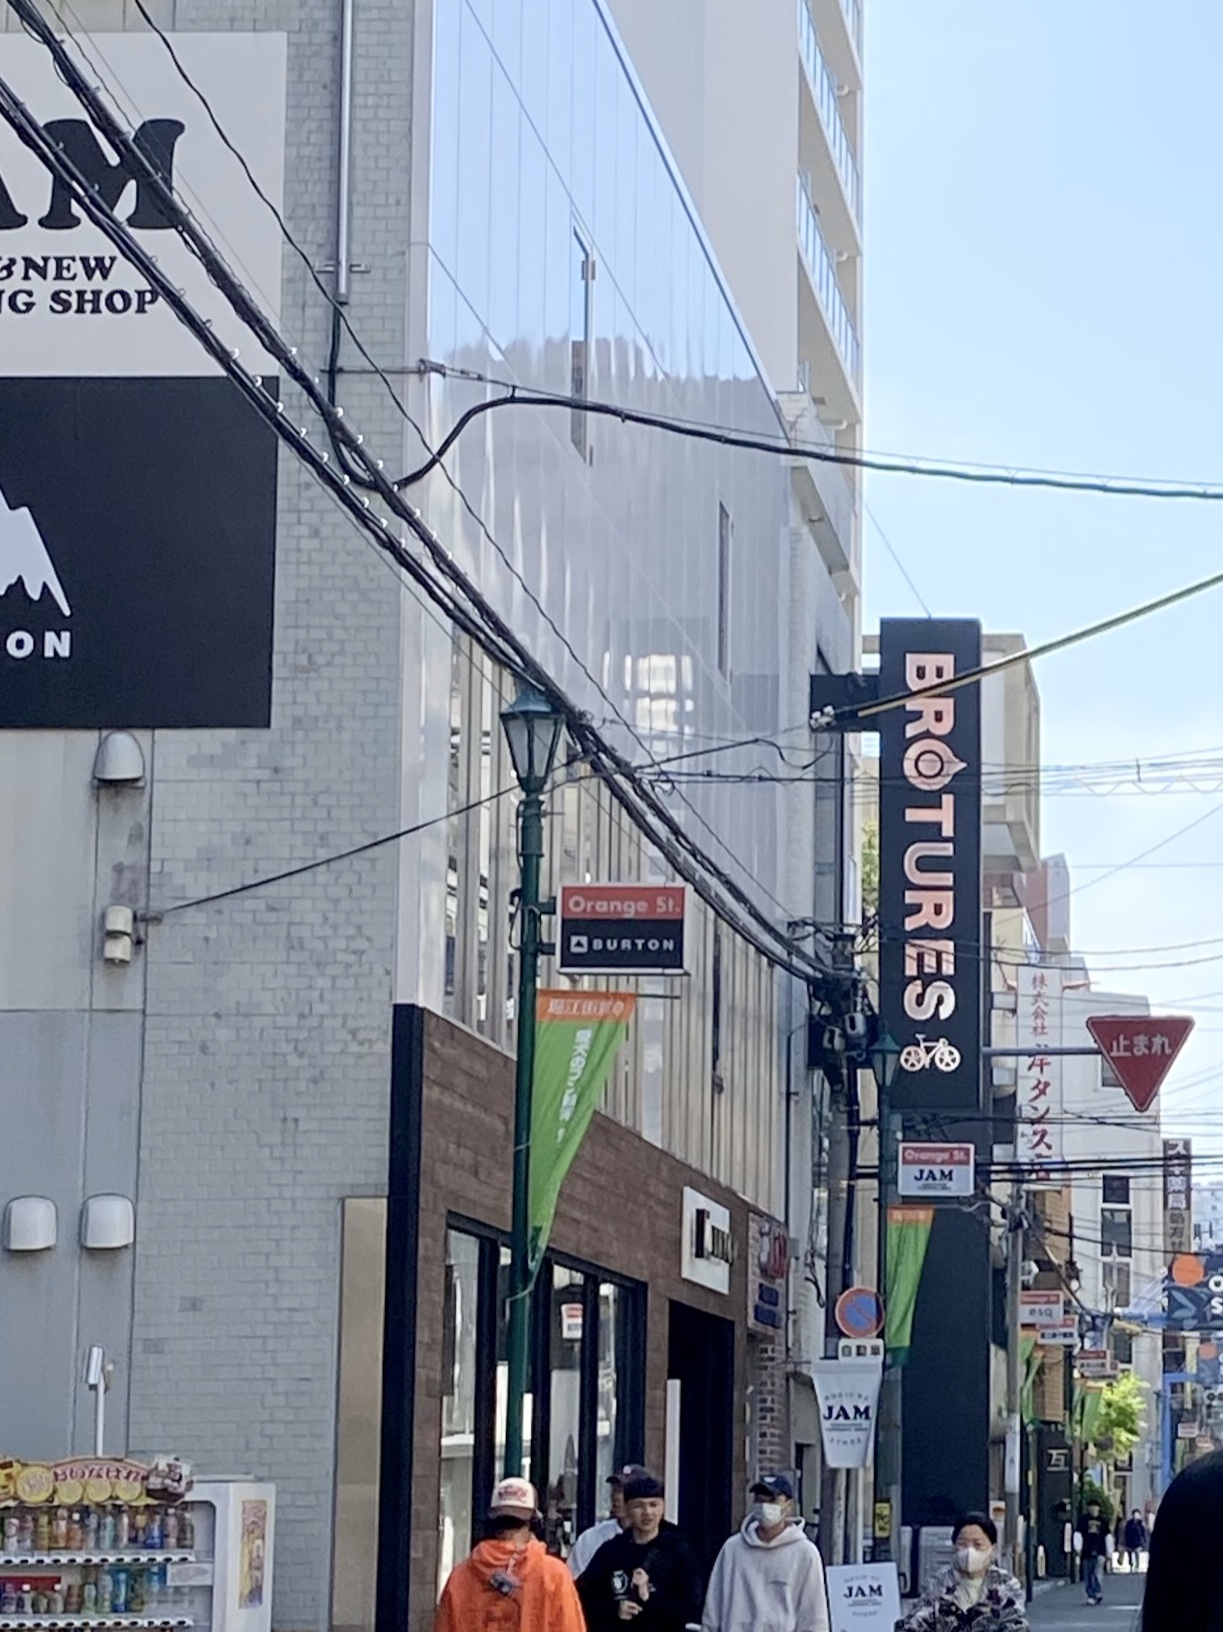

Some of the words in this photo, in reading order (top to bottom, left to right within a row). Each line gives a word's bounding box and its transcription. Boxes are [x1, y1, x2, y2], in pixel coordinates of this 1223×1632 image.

[49, 289, 160, 314] SHOP
[903, 652, 967, 1021] BROTURES
[568, 895, 648, 918] Orange
[656, 896, 681, 913] St.
[592, 938, 675, 951] BURTON
[1109, 1033, 1173, 1057] 止まれ
[914, 1169, 953, 1182] JAM
[824, 1405, 872, 1421] JAM
[843, 1584, 883, 1598] JAM
